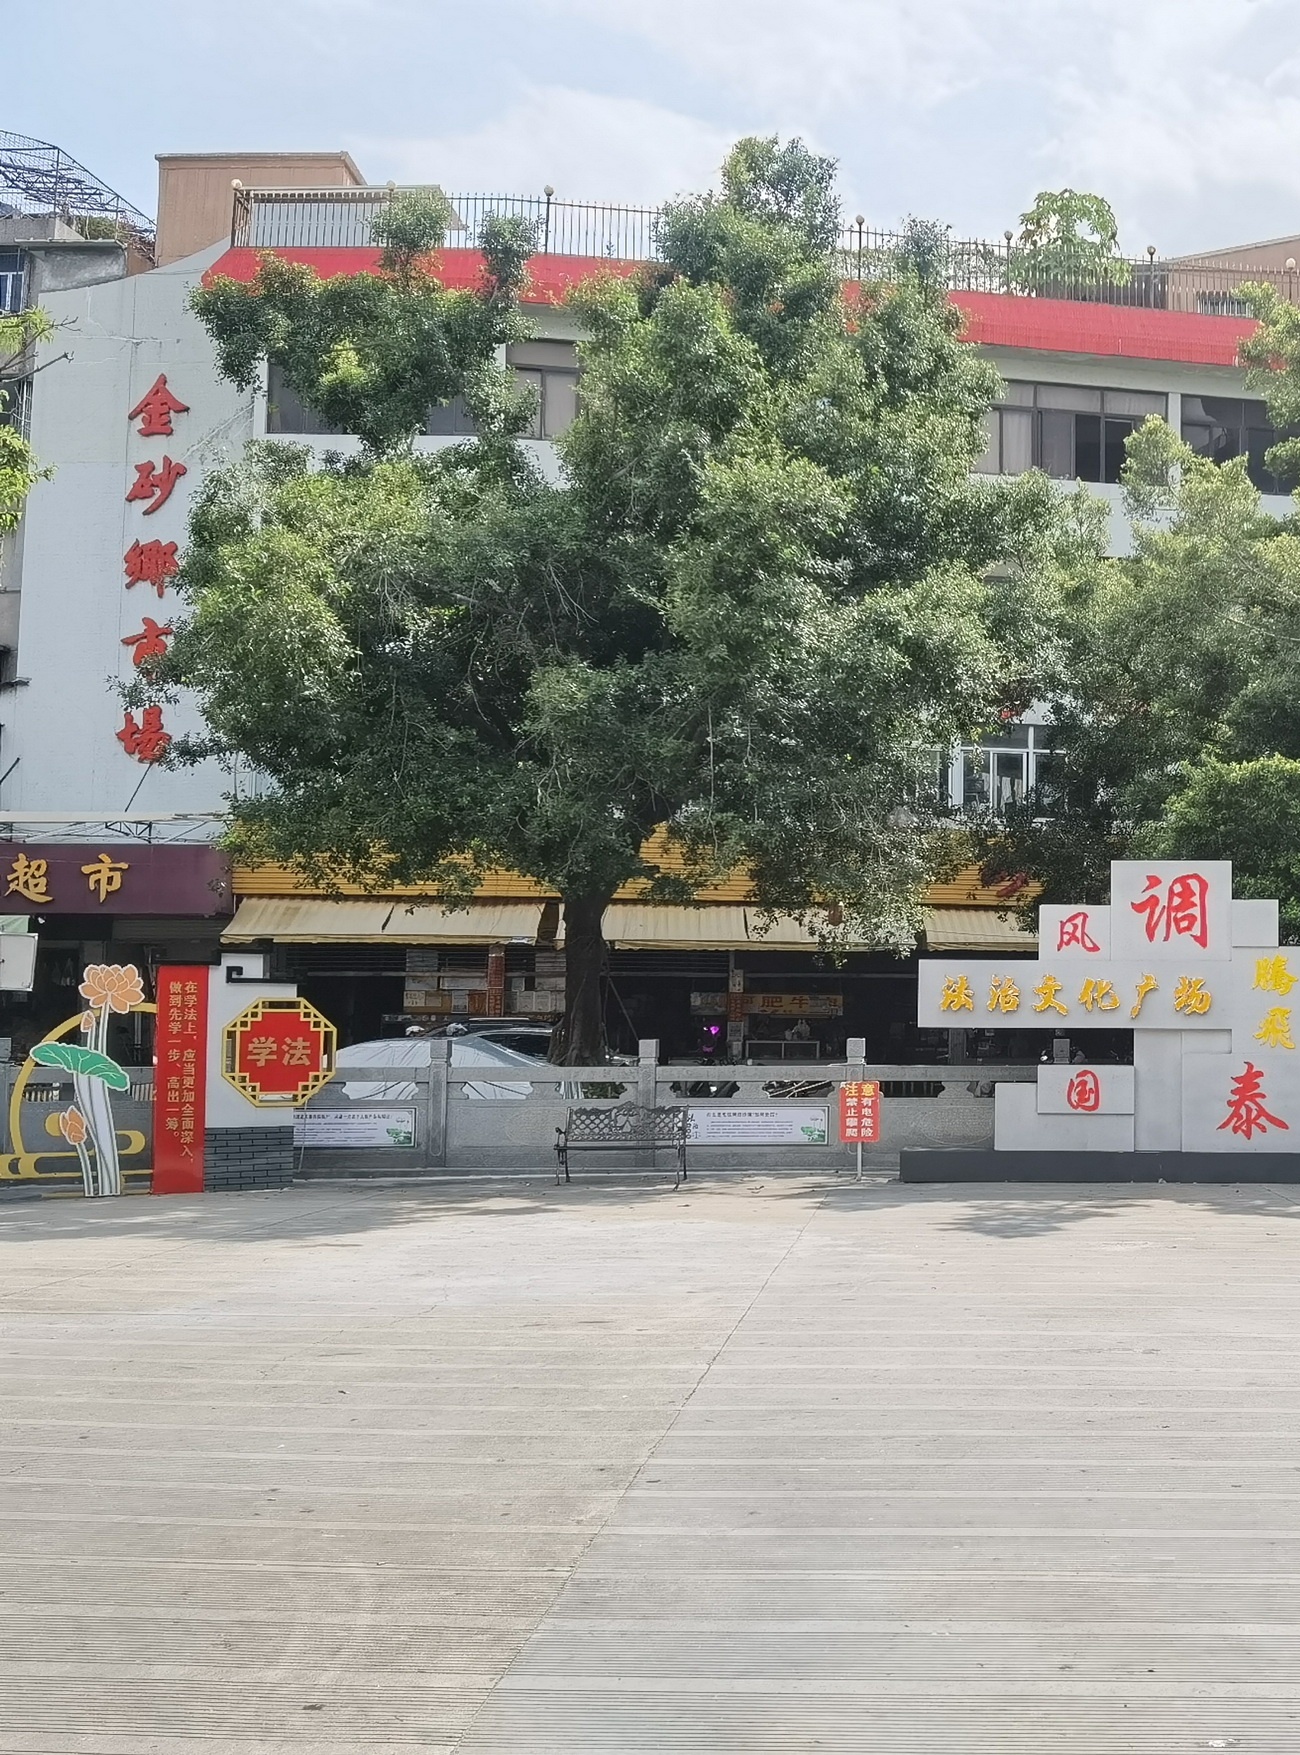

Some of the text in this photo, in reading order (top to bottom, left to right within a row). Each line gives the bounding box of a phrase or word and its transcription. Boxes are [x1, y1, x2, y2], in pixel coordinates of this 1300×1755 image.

[4, 853, 129, 903] 超市
[940, 973, 1212, 1018] 法治文化广场
[247, 1037, 311, 1067] 学法
[845, 1082, 876, 1097] 注意
